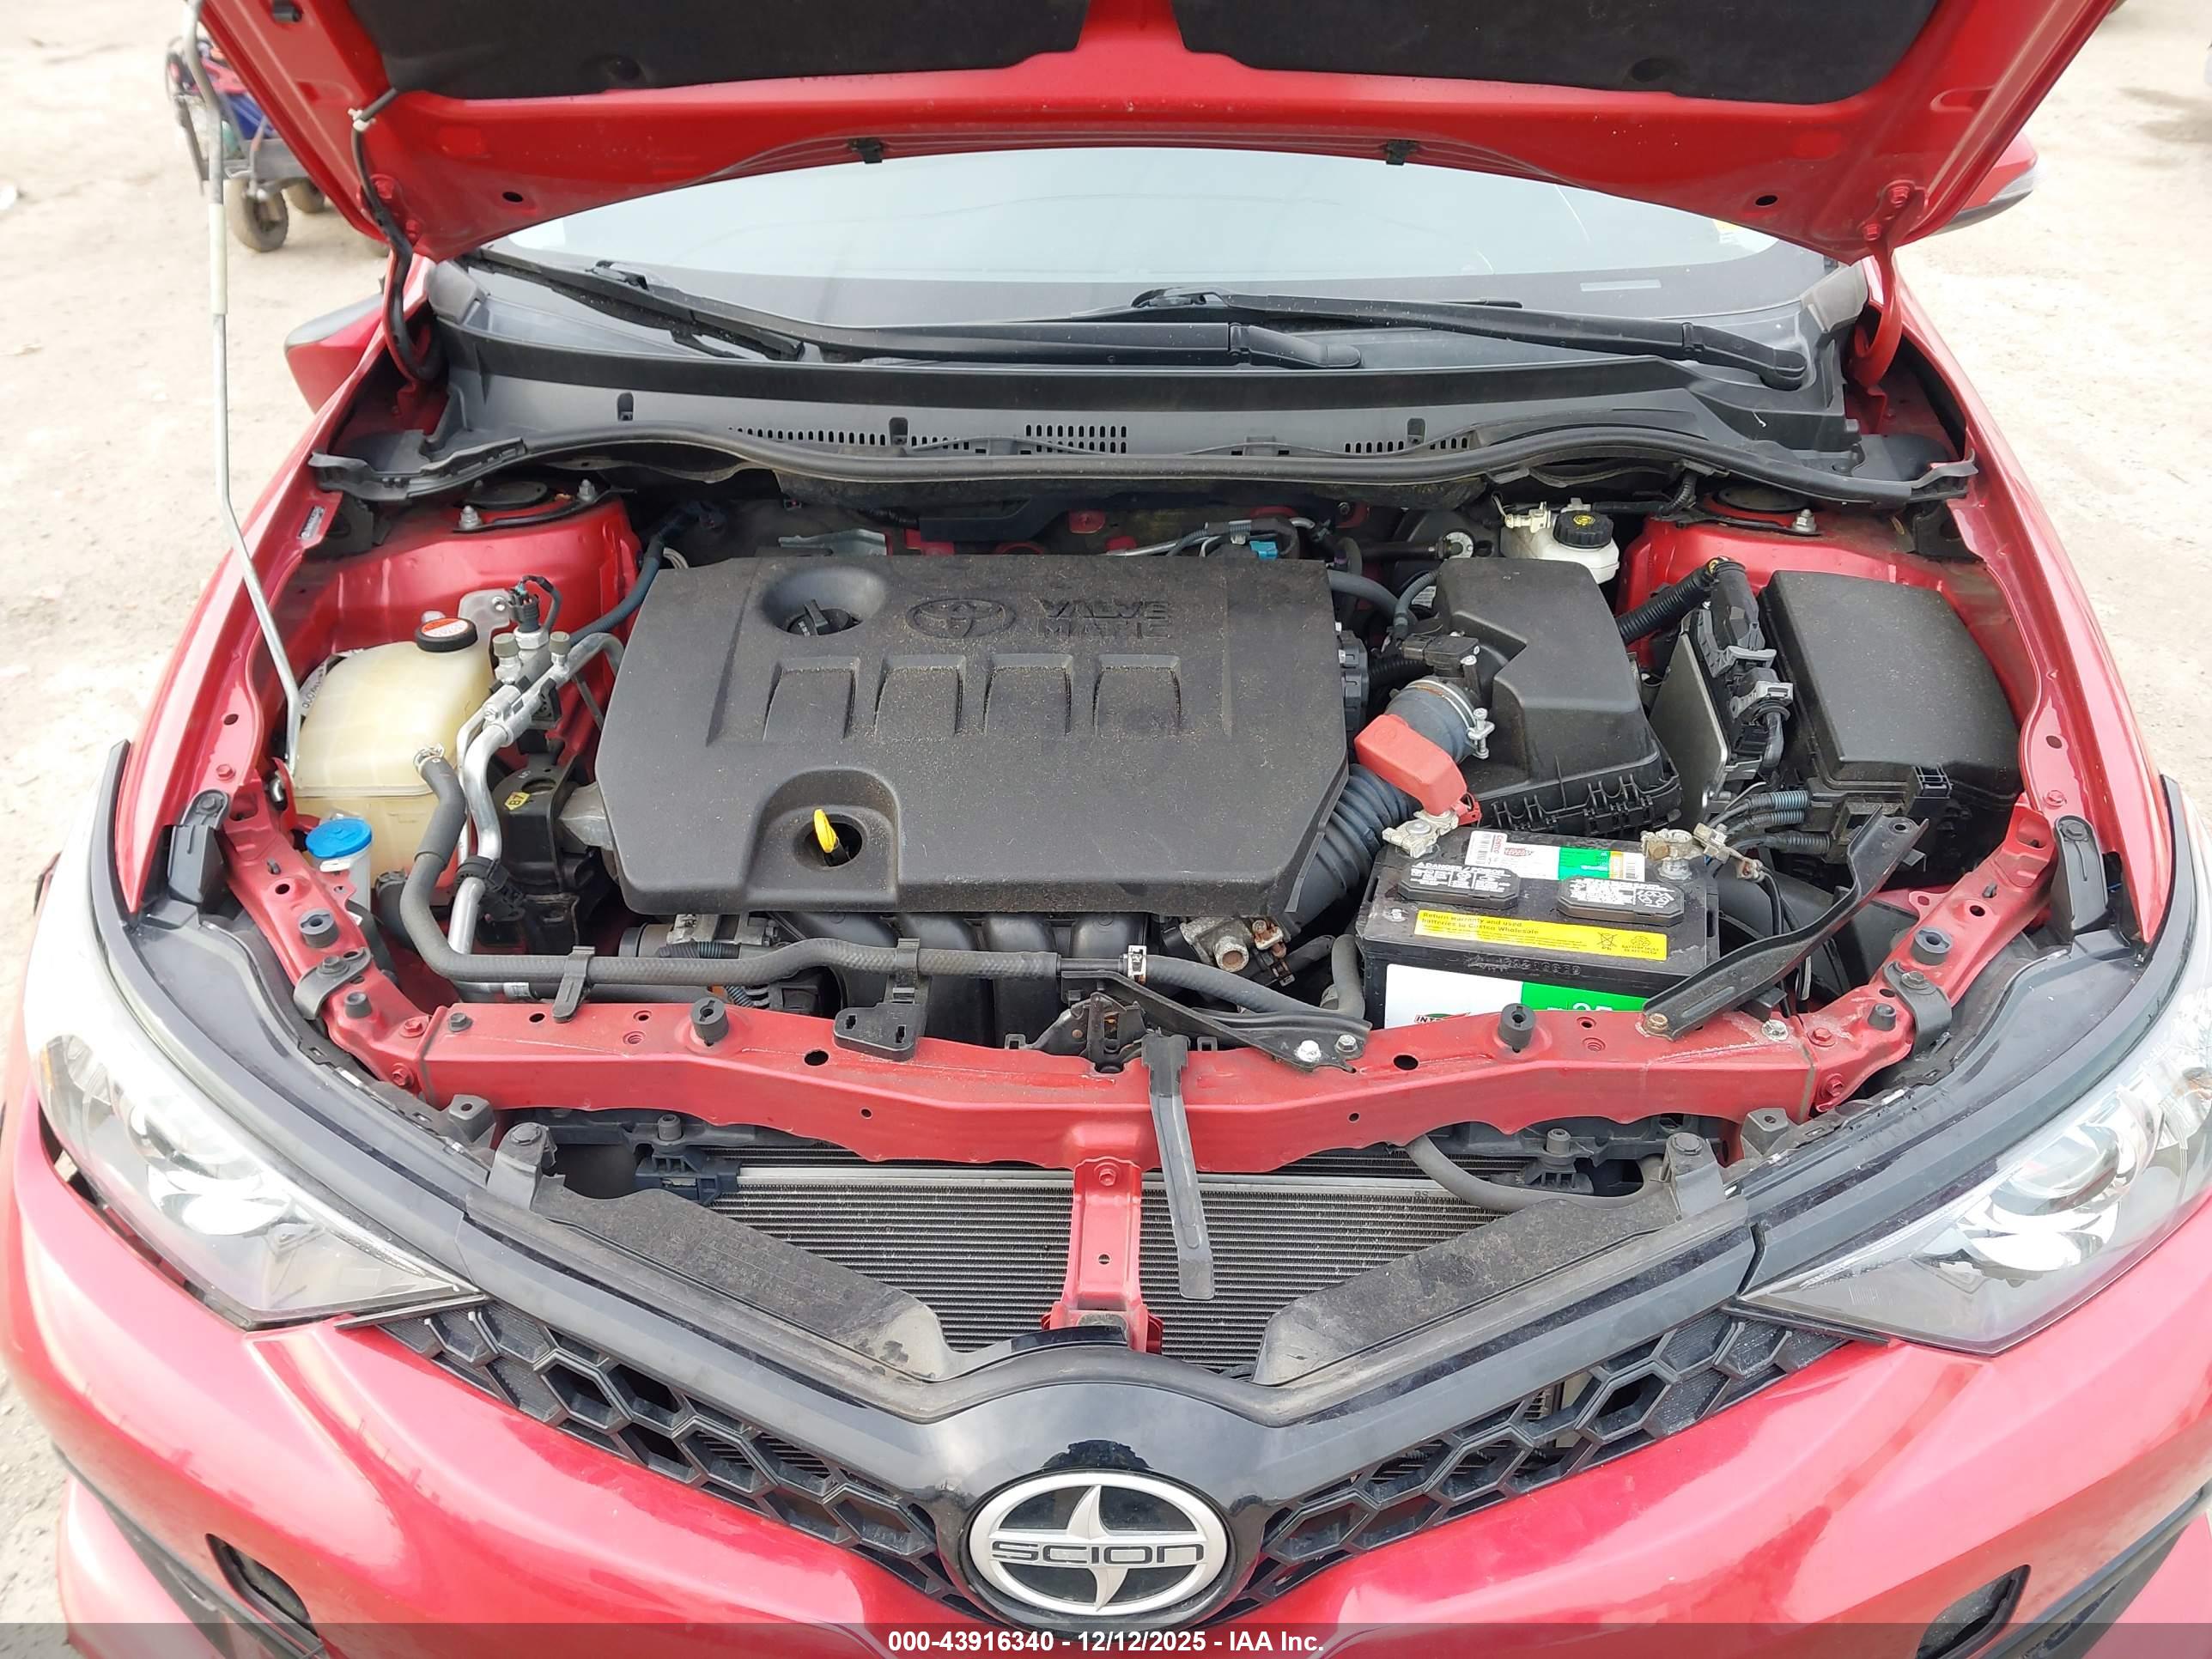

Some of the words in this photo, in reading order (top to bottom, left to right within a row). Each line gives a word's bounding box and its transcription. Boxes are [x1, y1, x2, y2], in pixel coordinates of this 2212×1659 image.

[1036, 599, 1169, 618] VALVE
[1422, 918, 1456, 927] batteries
[1498, 927, 1539, 935] Wholesale
[1423, 912, 1449, 921] Return
[1450, 915, 1484, 924] warranty
[991, 1540, 1204, 1565] SCION
